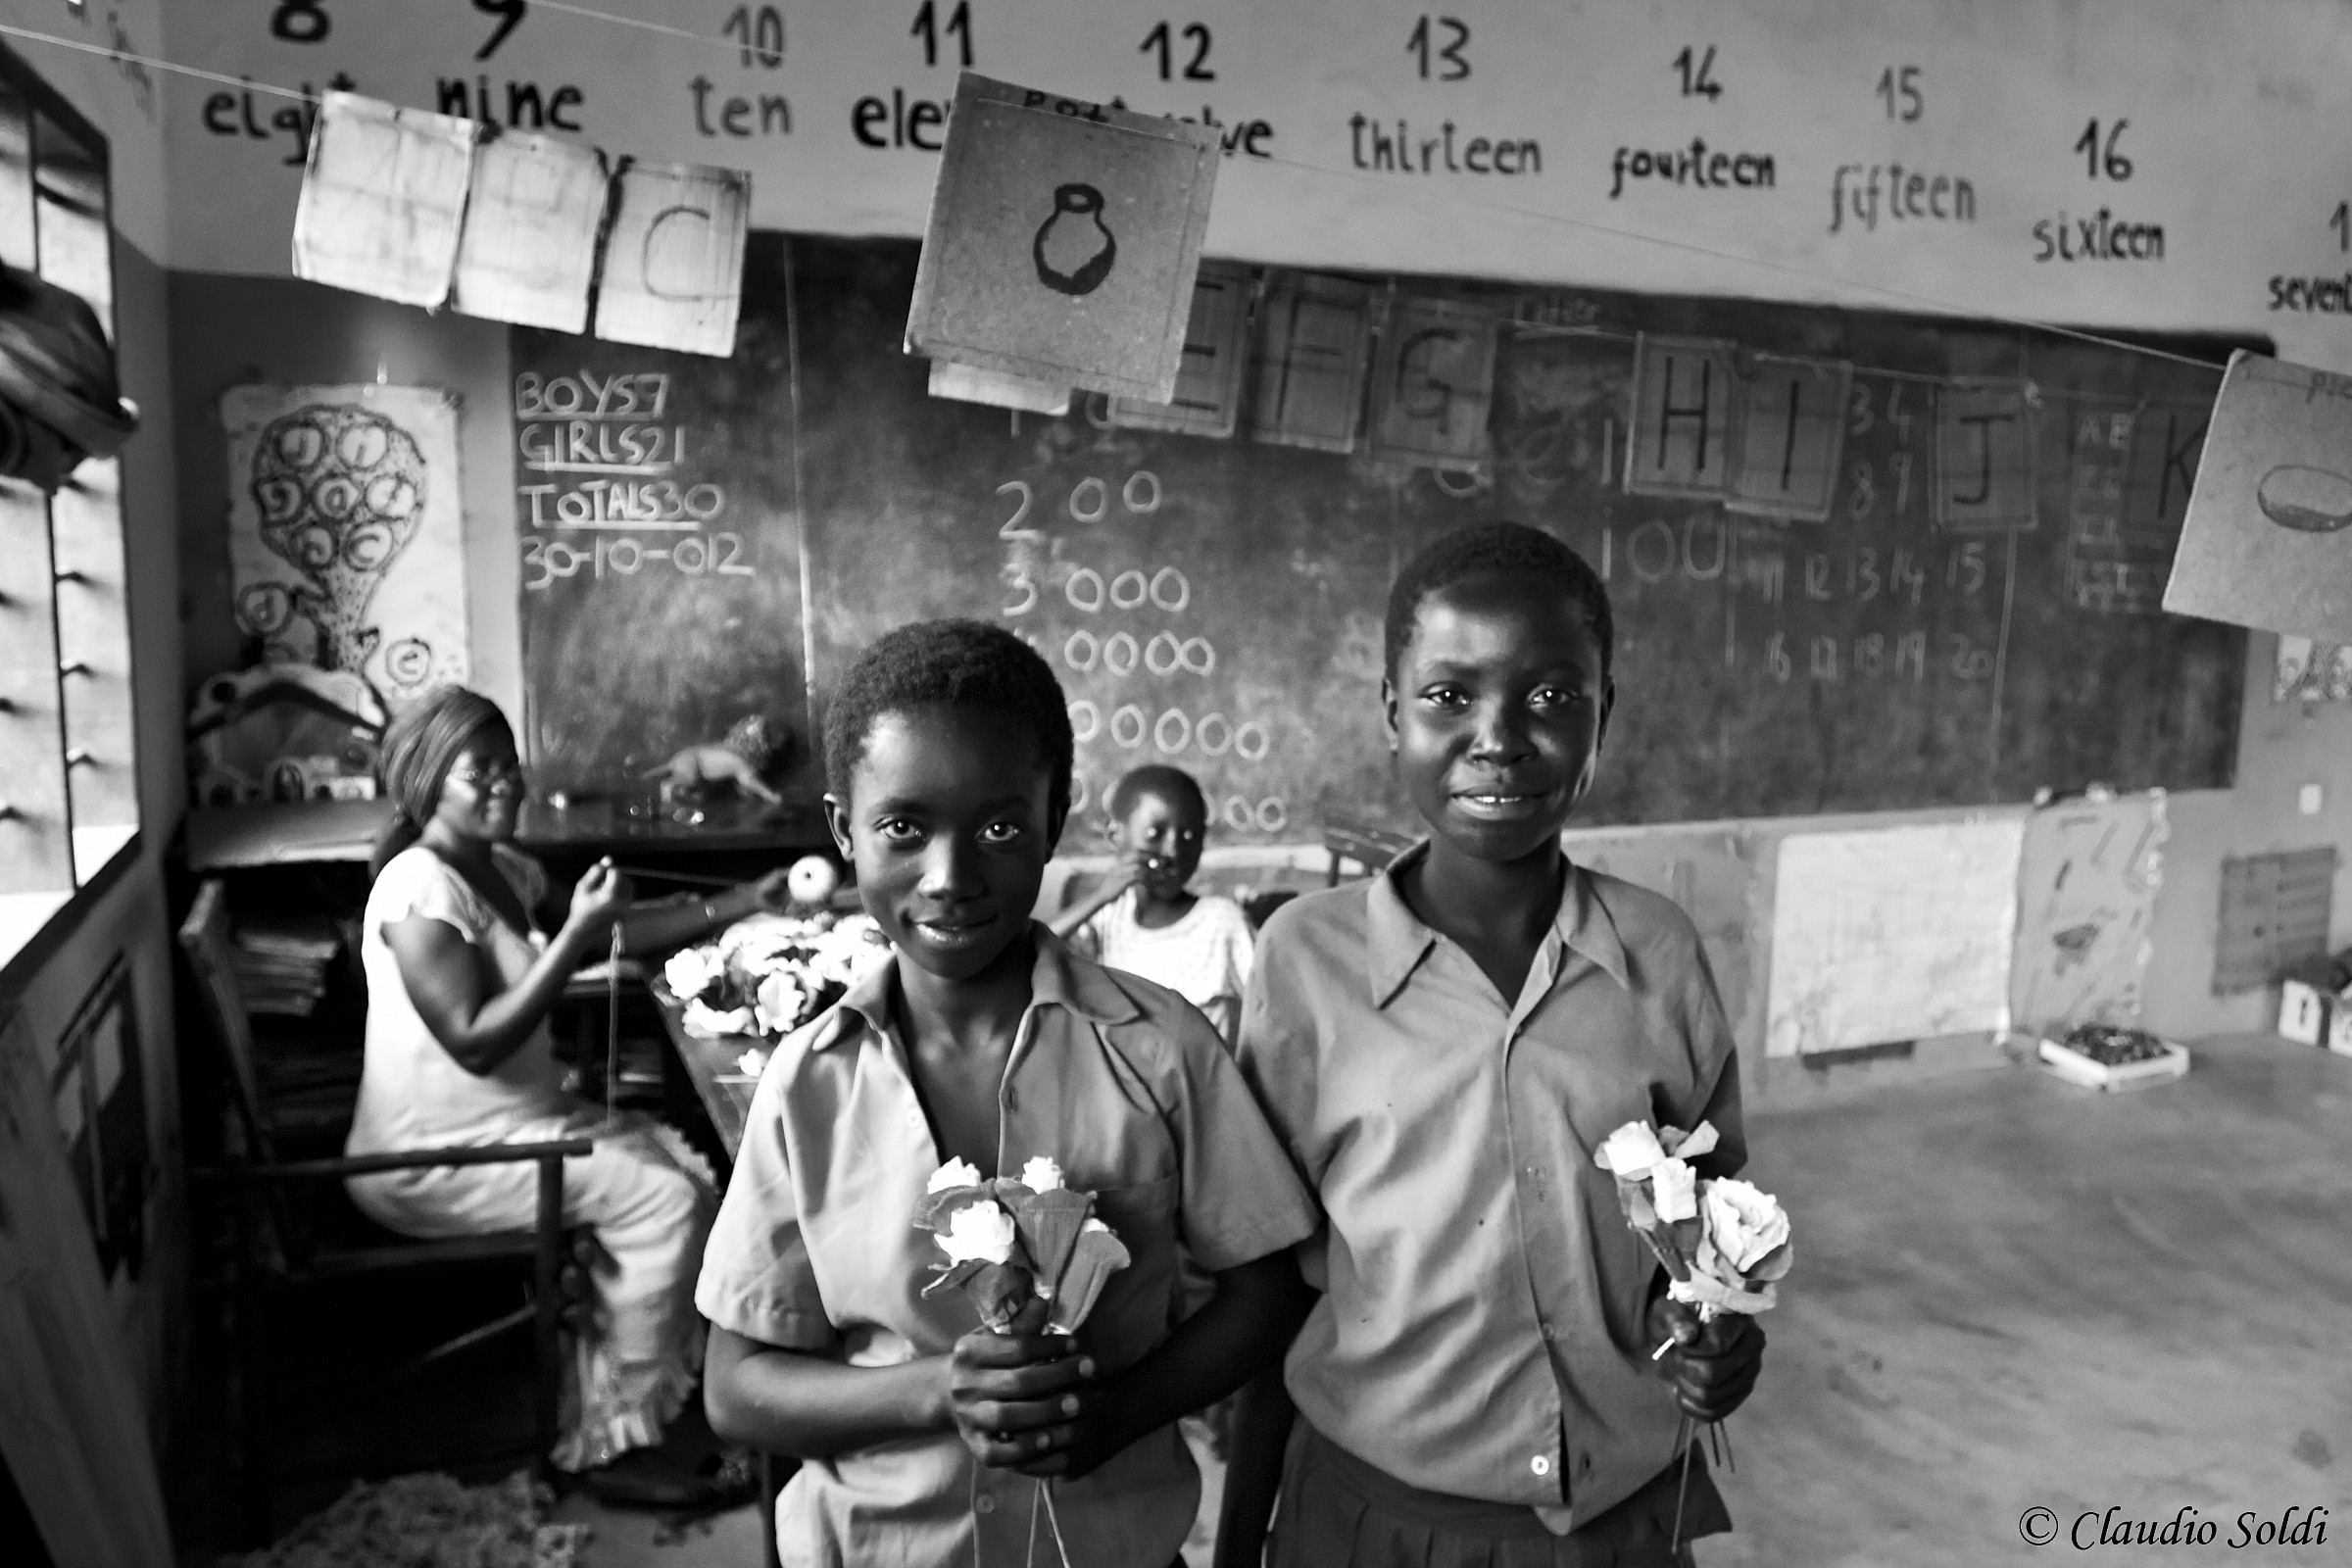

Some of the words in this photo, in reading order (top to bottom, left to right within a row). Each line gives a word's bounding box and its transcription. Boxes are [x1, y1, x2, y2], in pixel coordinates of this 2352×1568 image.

[722, 6, 784, 68] 10
[909, 0, 973, 67] 11
[1140, 20, 1215, 81] 12
[1405, 15, 1472, 80] 13
[1671, 44, 1722, 100] 14
[1876, 65, 1924, 122] 15
[435, 74, 586, 135] nine
[688, 75, 796, 138] ten
[1348, 112, 1543, 174] thirteen
[1609, 137, 1777, 199] fourteen
[2074, 117, 2132, 182] 16
[1829, 165, 1977, 235] fifteen
[2033, 206, 2165, 263] sixteen
[1657, 355, 1711, 474] H
[1952, 412, 2016, 507] J
